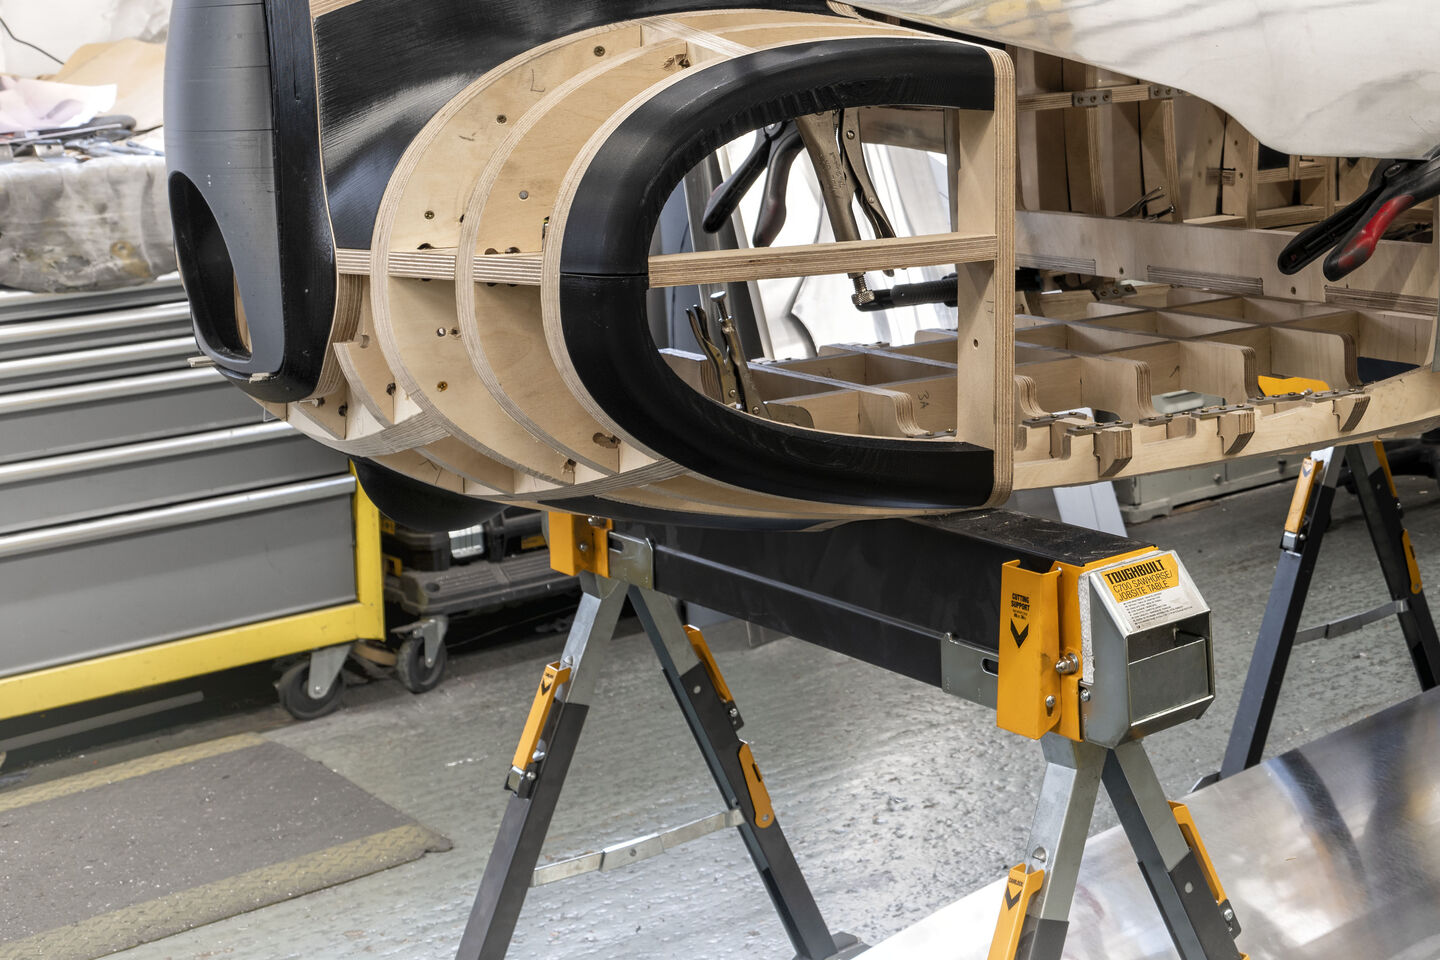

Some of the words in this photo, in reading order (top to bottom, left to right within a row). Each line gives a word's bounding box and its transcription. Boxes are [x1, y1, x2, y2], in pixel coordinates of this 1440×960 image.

[1105, 559, 1165, 584] TOUGHBUILT
[1113, 580, 1132, 593] C700
[1118, 586, 1147, 601] JOBSITE
[1146, 580, 1169, 593] TABLE
[1012, 592, 1029, 603] CUTTING
[1011, 600, 1030, 611] SUPPORT
